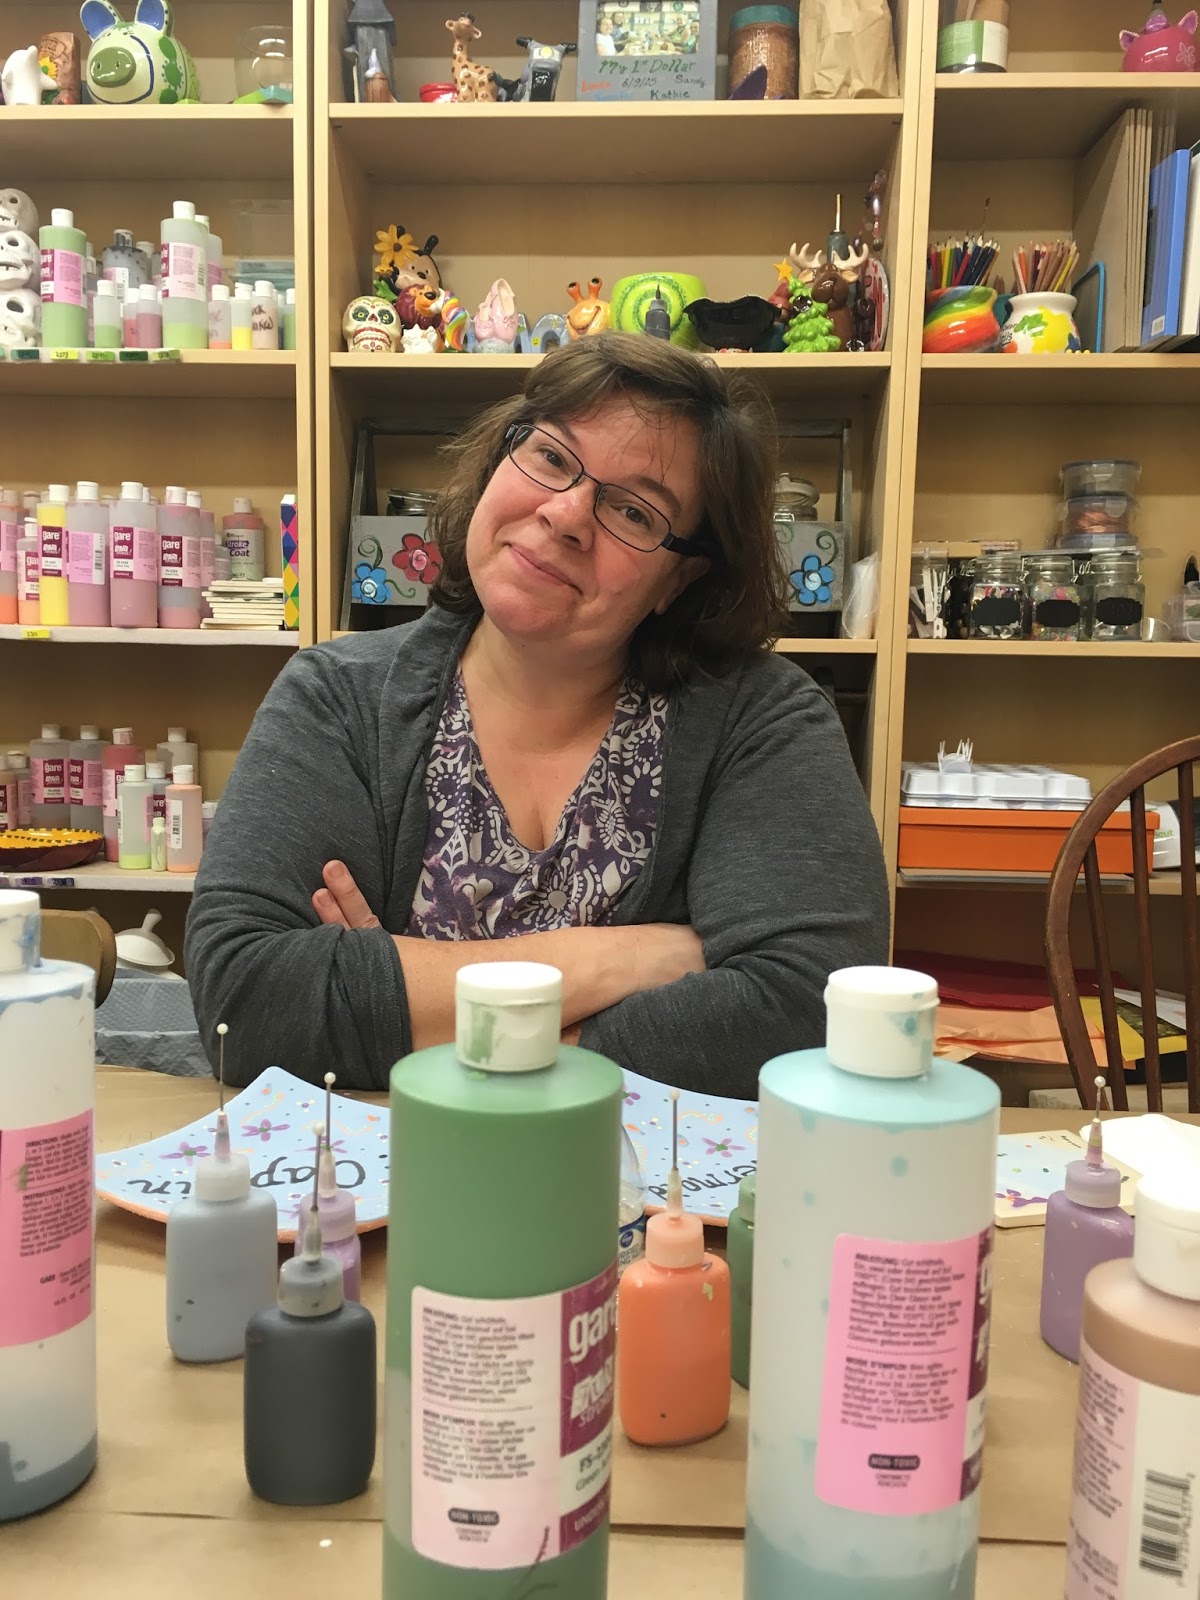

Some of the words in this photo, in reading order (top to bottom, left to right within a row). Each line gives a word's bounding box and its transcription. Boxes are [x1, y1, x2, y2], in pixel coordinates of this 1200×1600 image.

[599, 60, 627, 74] My
[649, 59, 697, 74] Dollar
[674, 74, 706, 89] Sandy
[650, 89, 690, 101] Kathie
[42, 531, 60, 541] gare
[114, 532, 131, 542] gare
[162, 540, 180, 550] gare
[230, 549, 250, 557] Coat
[44, 763, 62, 774] gare
